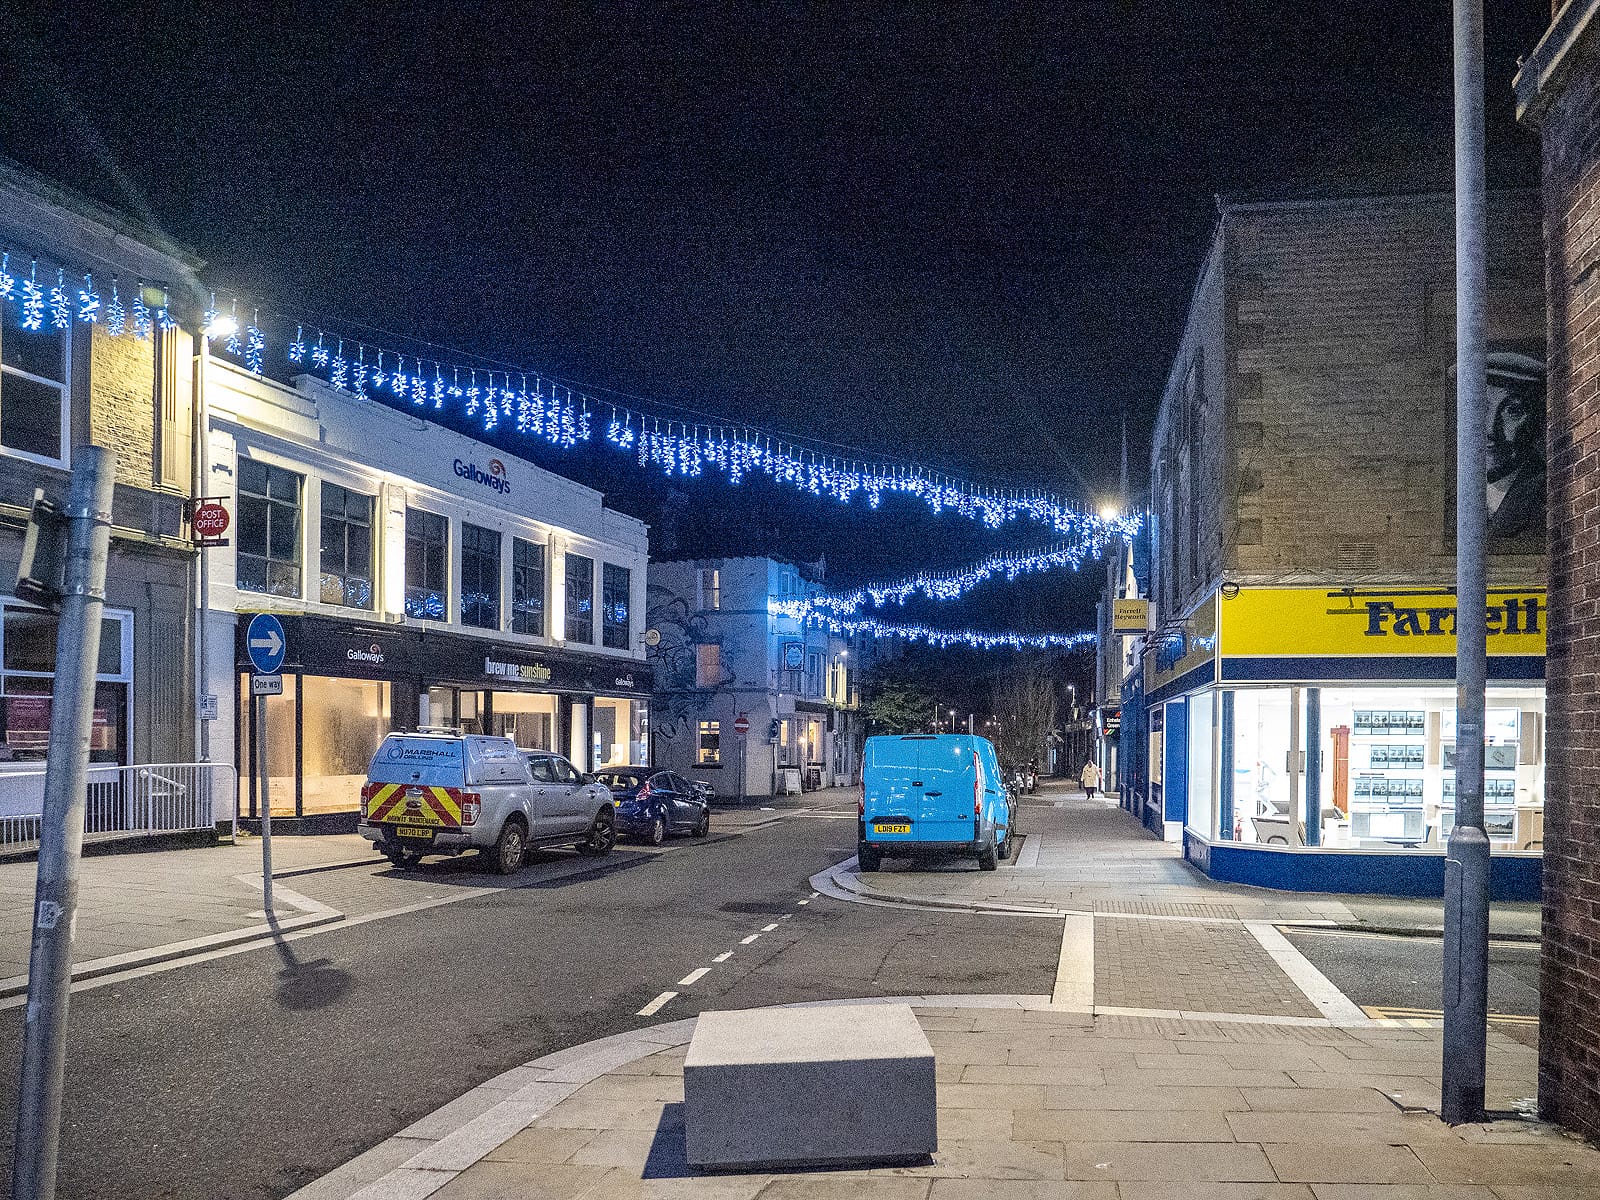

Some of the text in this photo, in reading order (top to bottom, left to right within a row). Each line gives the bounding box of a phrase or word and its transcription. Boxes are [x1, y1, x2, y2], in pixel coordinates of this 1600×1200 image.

[453, 458, 511, 494] Galloways
[201, 509, 222, 519] POST
[196, 519, 224, 528] OFFICE
[347, 648, 384, 663] Galloways
[484, 656, 551, 680] brew me sunshine
[254, 679, 281, 690] One way
[404, 748, 456, 758] MARSHALL
[877, 825, 907, 833] LD19 FZT
